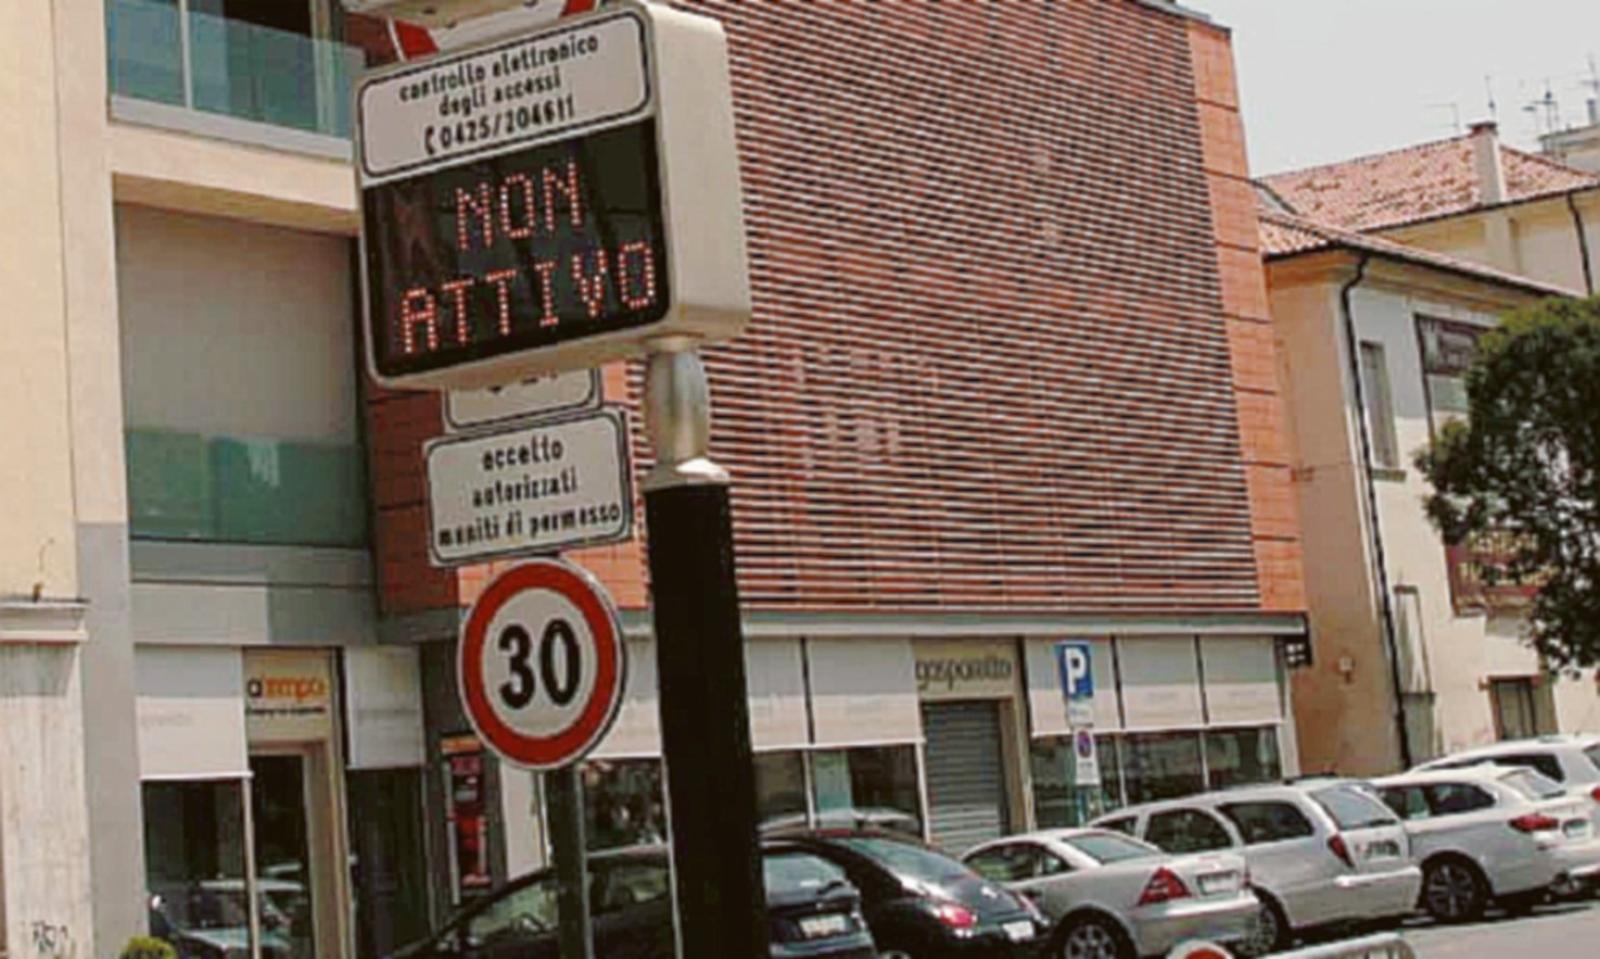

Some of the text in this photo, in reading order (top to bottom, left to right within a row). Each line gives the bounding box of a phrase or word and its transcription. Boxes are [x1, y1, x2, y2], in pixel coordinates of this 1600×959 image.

[400, 35, 600, 102] controllo elettronico
[439, 65, 562, 117] degli accessi
[456, 161, 583, 250] NON
[402, 241, 656, 355] ATTIVO
[483, 435, 564, 471] eccetto
[473, 467, 578, 508] autorizzati
[439, 503, 621, 547] muniti di permesso
[498, 618, 582, 710] 30
[1064, 647, 1087, 694] P
